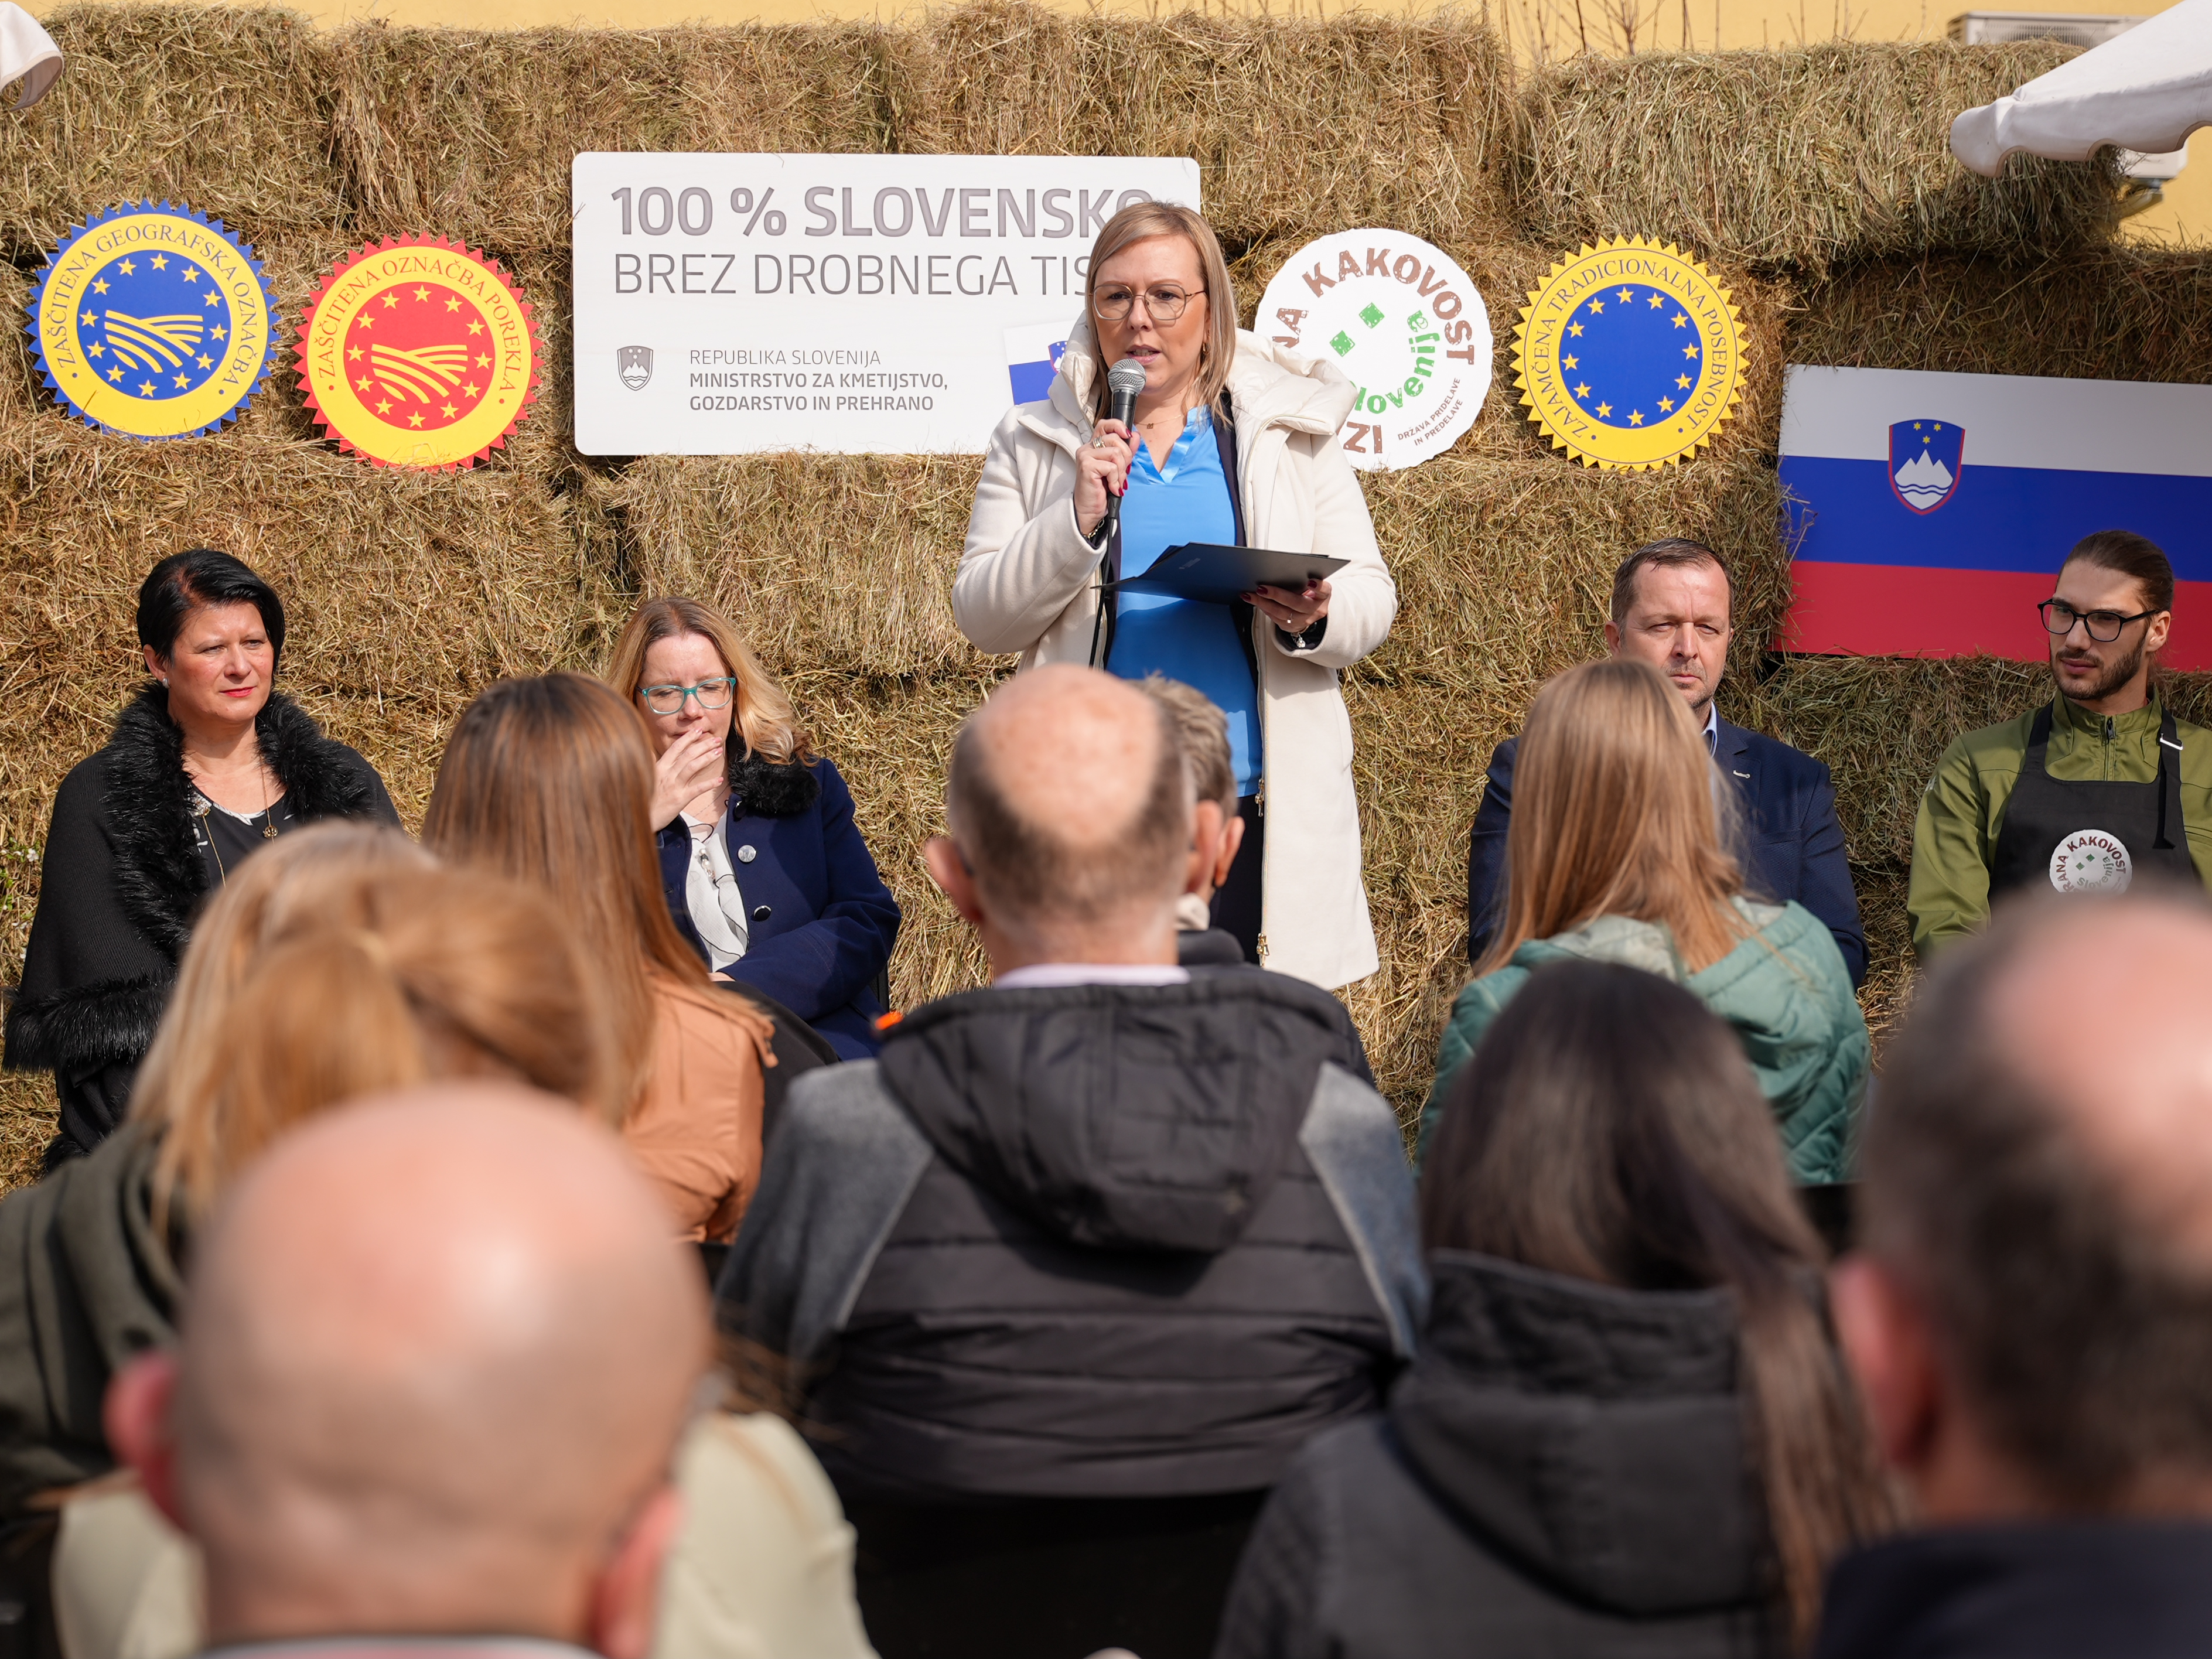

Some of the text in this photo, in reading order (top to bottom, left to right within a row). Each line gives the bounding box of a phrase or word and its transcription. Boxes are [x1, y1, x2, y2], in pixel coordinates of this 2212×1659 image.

[612, 187, 713, 235] 100
[730, 187, 787, 236] %
[615, 253, 736, 294] BREZ
[755, 254, 1018, 295] DROBNEGA
[46, 224, 258, 385] ZAŠČITENA GEOGRAFSKA OZNAČBA
[313, 255, 522, 391] ZAŠČITENA OZNAČBA POREKLA
[1302, 247, 1474, 365] KAKOVOST
[690, 350, 881, 368] REPUBLIKA SLOVENIJA
[1350, 310, 1440, 414] lovenija
[1530, 258, 1728, 438] ZAJAMČENA TRADICIONALNA POSEBNOST
[689, 396, 934, 410] GOZDARSTVO IN PREHRANO
[690, 373, 948, 391] MINISTRSTVO ZA KMETIJSTVO,
[1397, 377, 1460, 441] DRŽAVA PRIDELAVE
[1414, 399, 1463, 446] IN PREDELAVE
[2066, 836, 2126, 874] KAKOVOST
[2077, 856, 2114, 889] Slovenija
